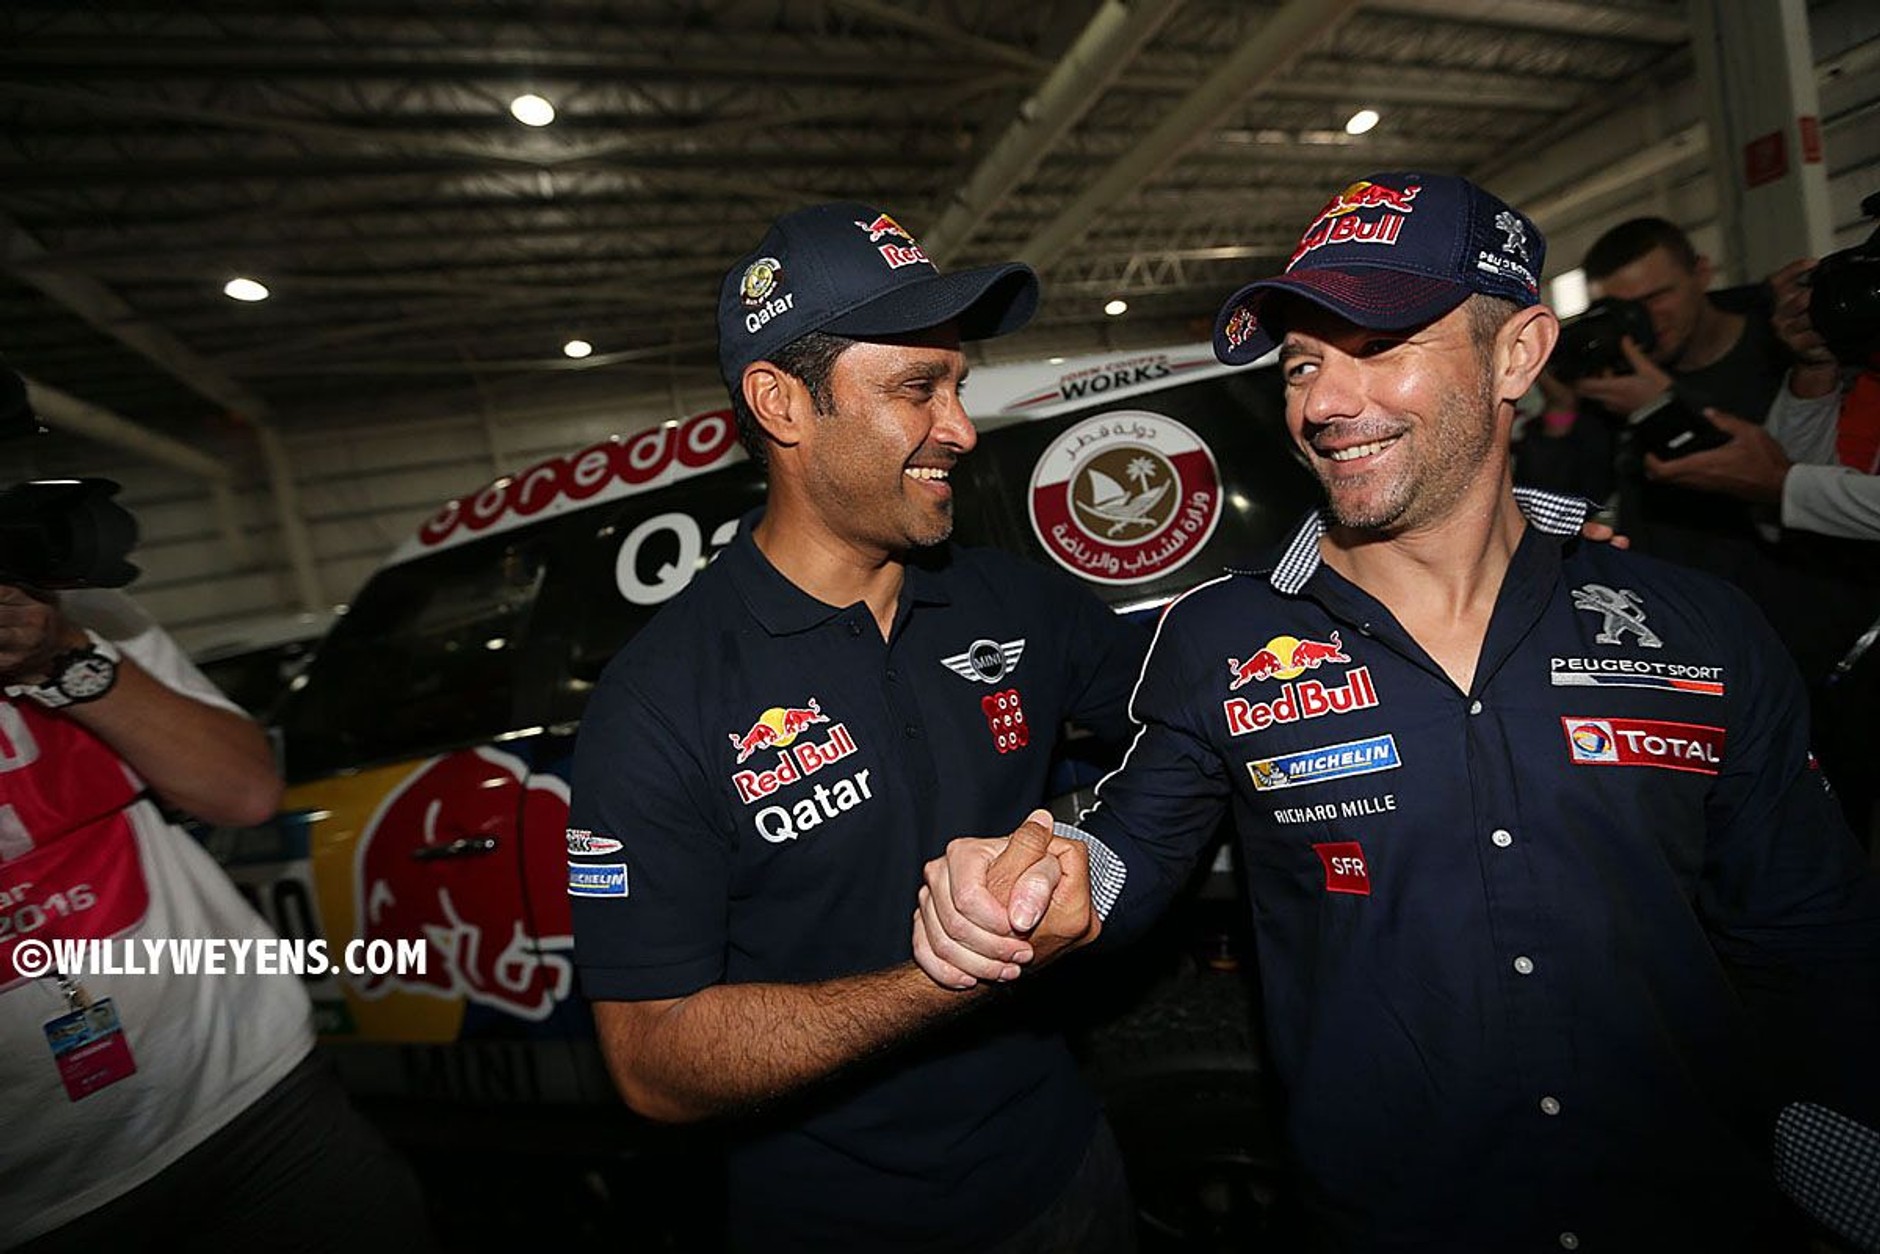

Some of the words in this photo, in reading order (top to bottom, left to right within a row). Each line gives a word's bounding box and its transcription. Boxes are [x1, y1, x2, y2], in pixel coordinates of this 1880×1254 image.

[1328, 214, 1405, 245] Bull
[746, 293, 794, 333] Qatar
[1062, 364, 1170, 399] WORKS
[427, 415, 727, 533] ooredo
[973, 653, 1001, 670] MINI
[1224, 684, 1300, 736] Red
[1297, 666, 1379, 719] Bull
[731, 750, 801, 804] Red
[793, 723, 858, 775] Bull
[1290, 745, 1389, 775] MICHELIN
[1616, 730, 1720, 763] TOTAL
[755, 768, 872, 843] Qatar
[1274, 803, 1338, 825] RICHARD
[1341, 795, 1396, 818] MILLE
[1332, 857, 1366, 877] SFR
